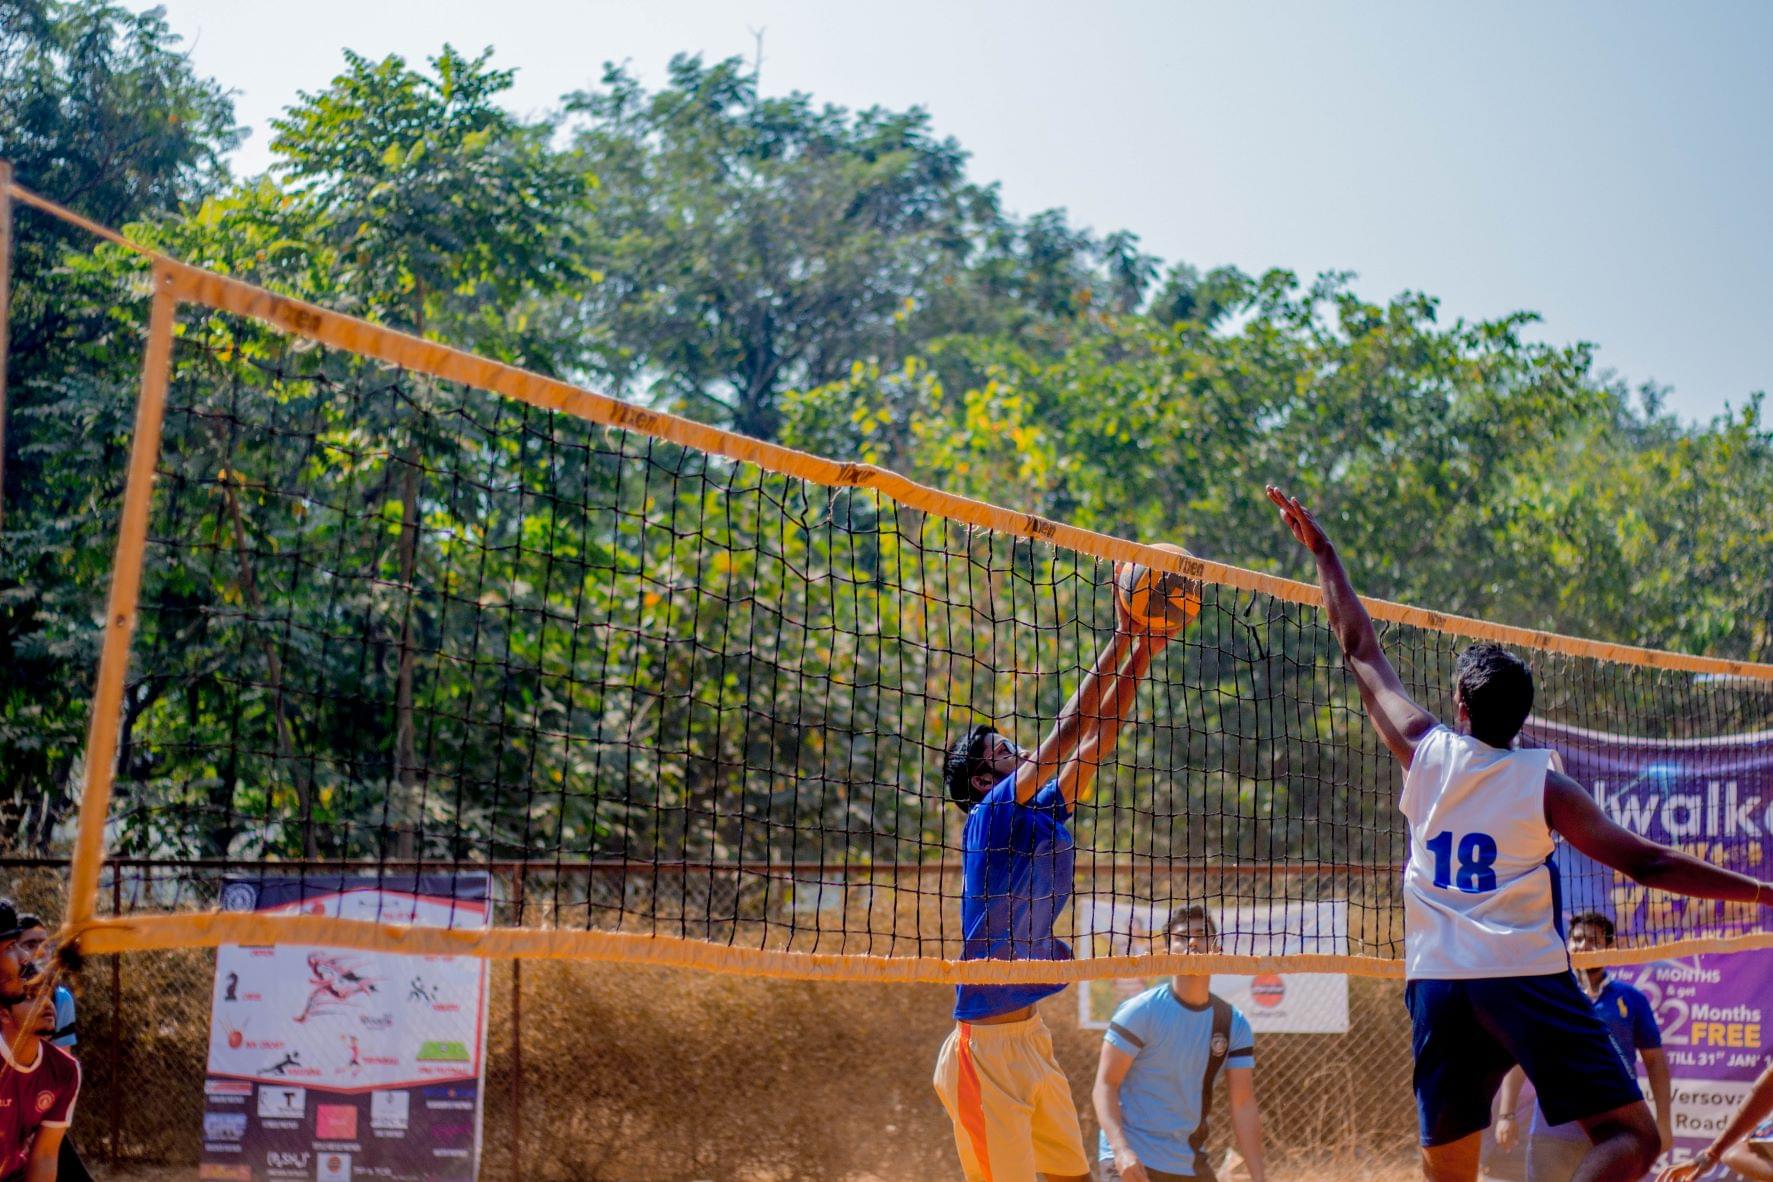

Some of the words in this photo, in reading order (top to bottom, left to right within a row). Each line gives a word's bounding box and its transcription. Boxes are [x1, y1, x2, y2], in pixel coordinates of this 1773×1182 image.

[1426, 831, 1497, 894] 18
[1656, 968, 1721, 984] MONTHS
[1677, 986, 1697, 998] get
[1659, 998, 1690, 1045] 2
[1691, 1003, 1762, 1022] Months
[1691, 1022, 1762, 1048] FREE
[1667, 1050, 1696, 1066] TILL
[1676, 1113, 1728, 1131] Road
